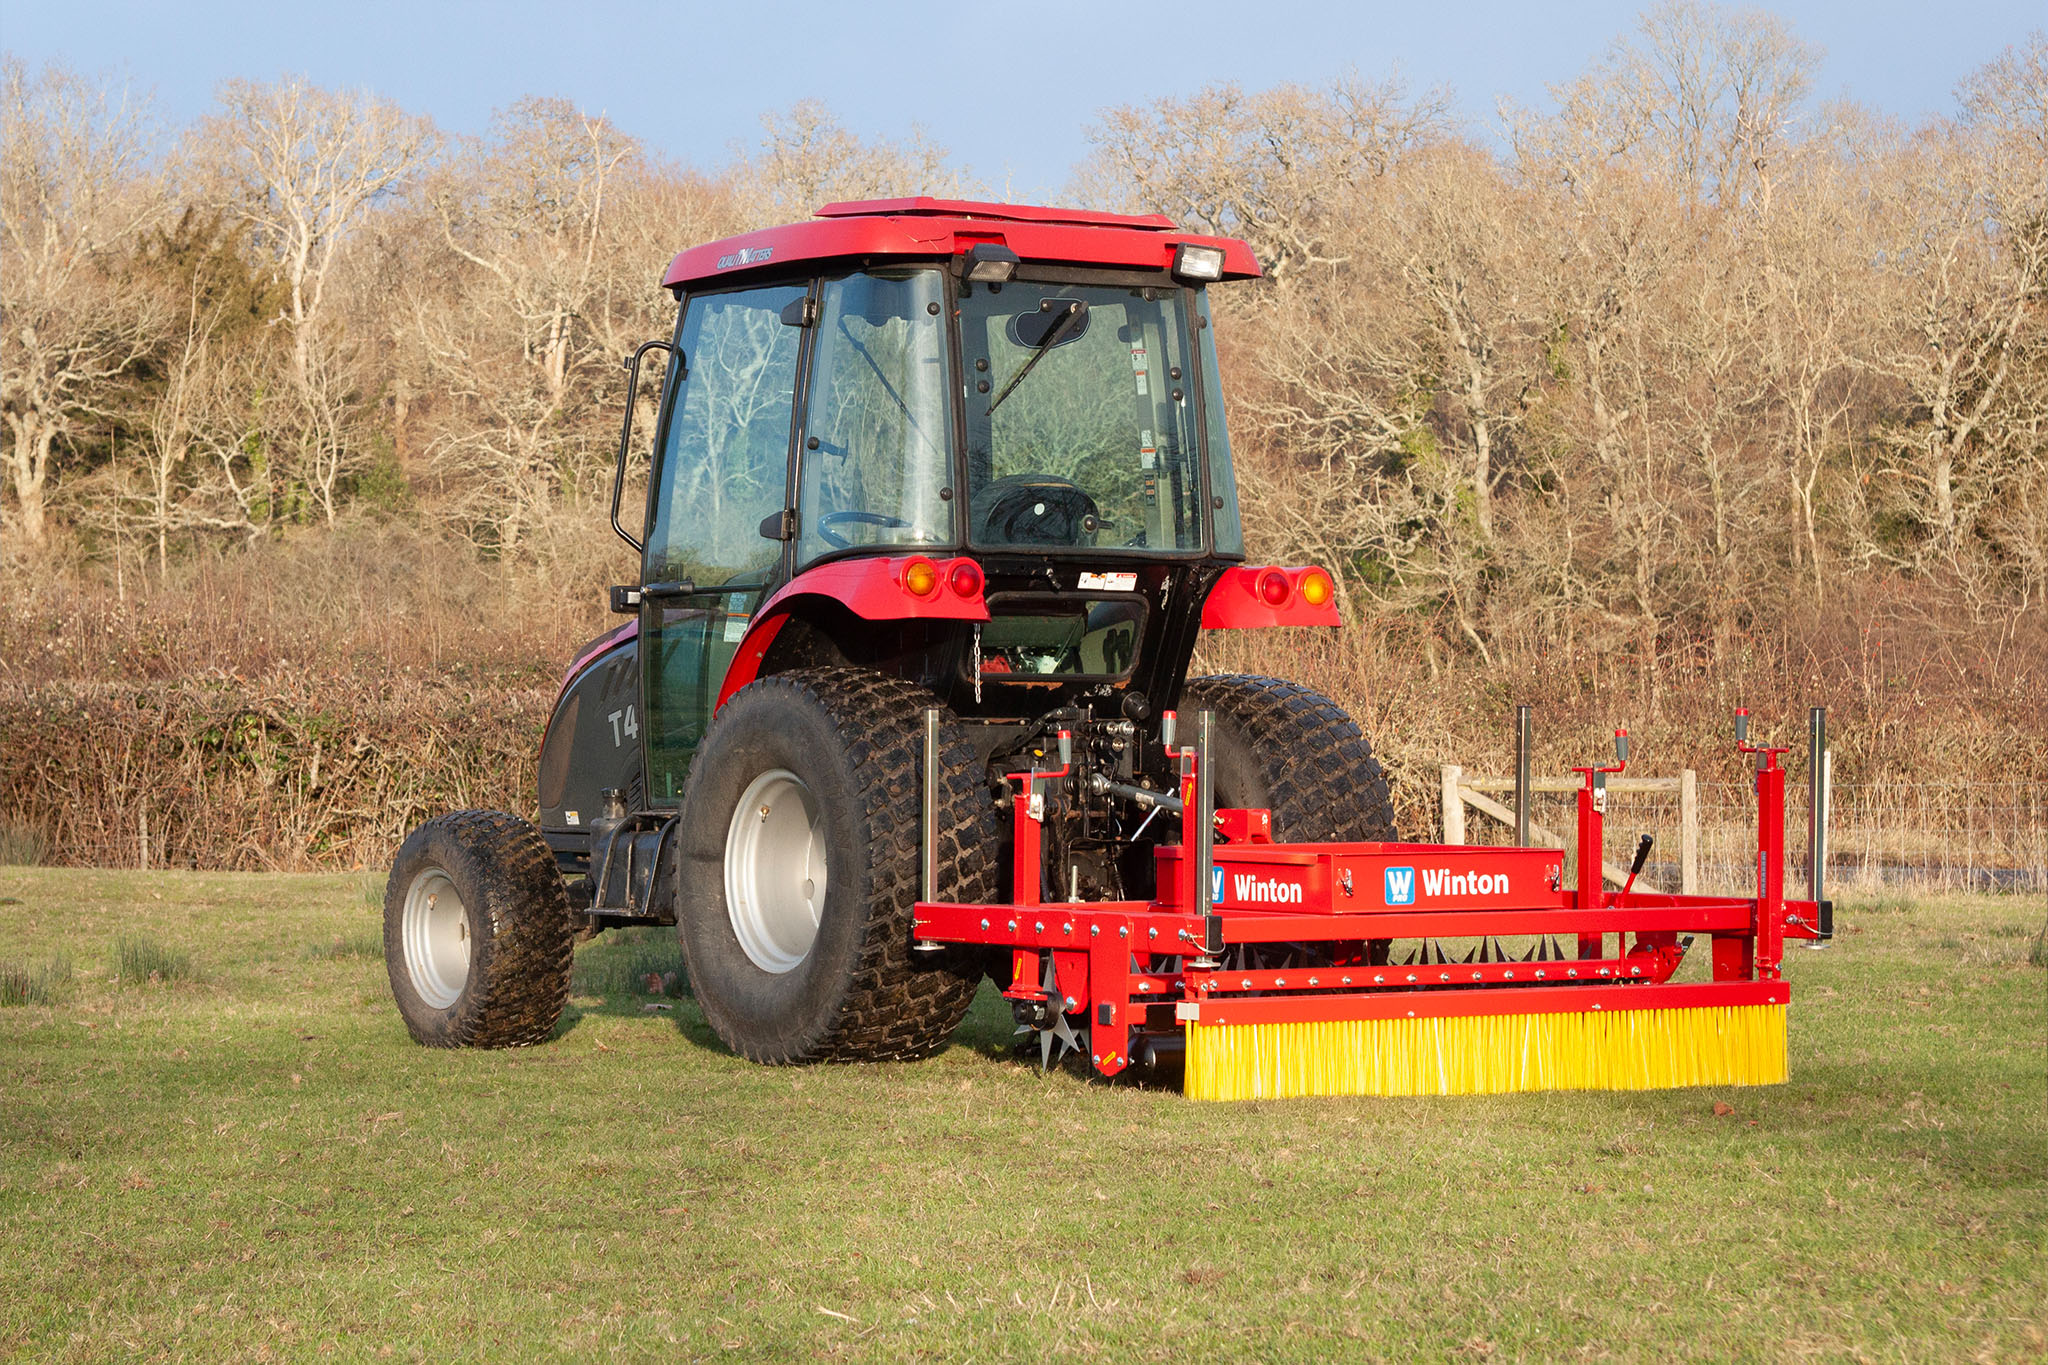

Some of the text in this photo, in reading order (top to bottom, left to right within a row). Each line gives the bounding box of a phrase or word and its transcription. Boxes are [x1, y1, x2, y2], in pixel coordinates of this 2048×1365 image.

[608, 704, 639, 748] T4
[1234, 874, 1303, 903] Winton
[1388, 871, 1412, 895] W
[1422, 868, 1509, 897] Winton
